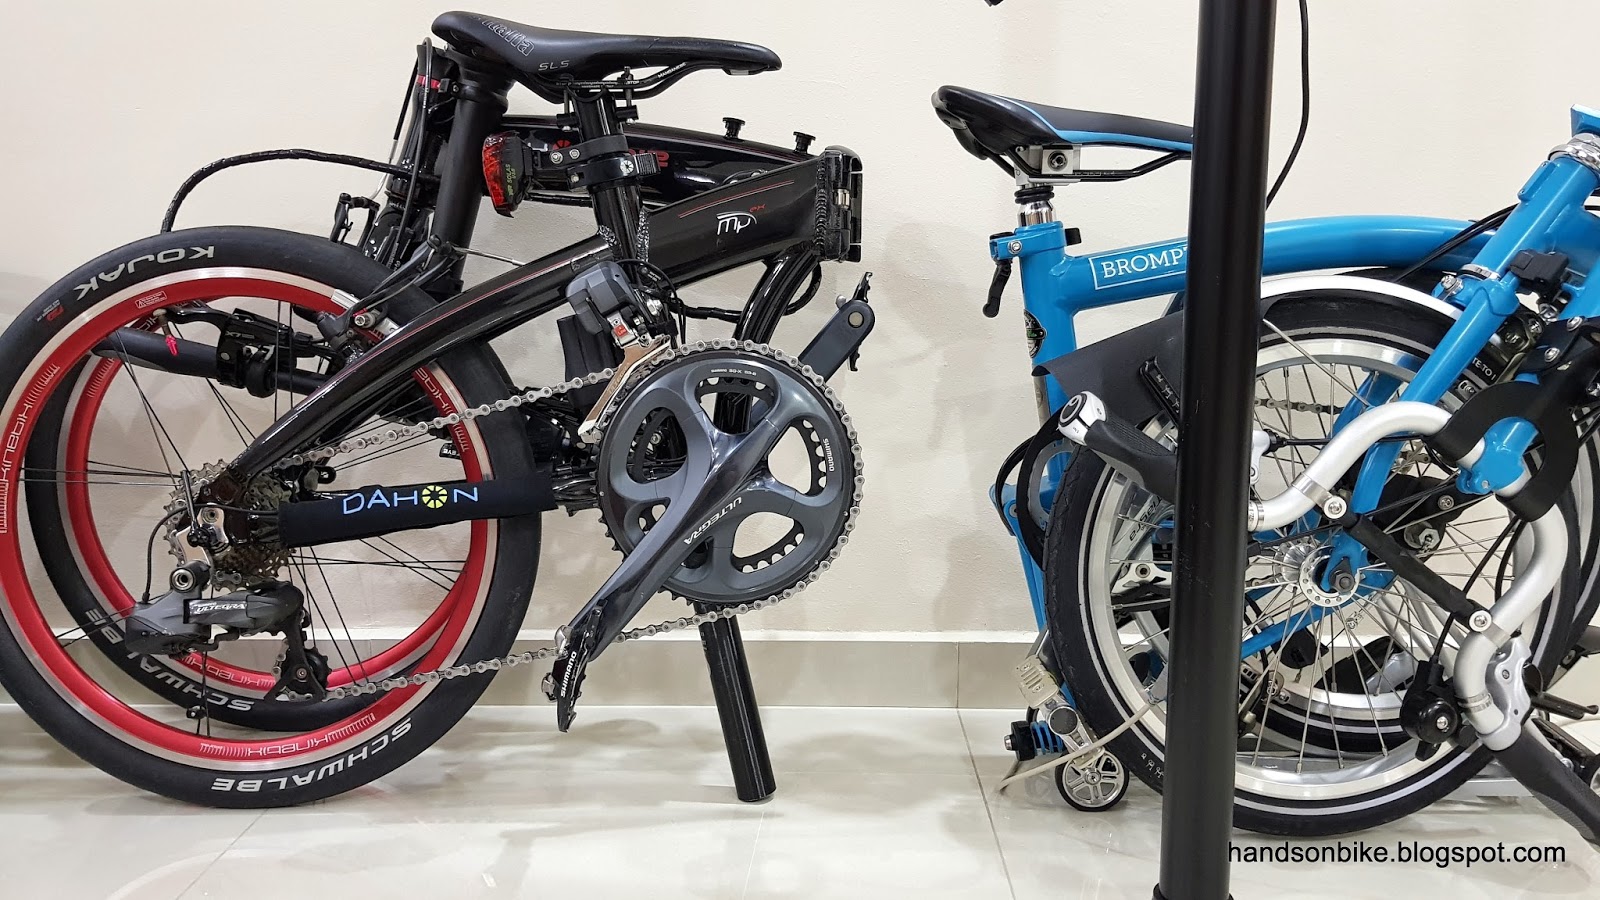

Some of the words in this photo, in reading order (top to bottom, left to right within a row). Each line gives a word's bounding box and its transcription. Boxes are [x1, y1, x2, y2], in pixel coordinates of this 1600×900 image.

[538, 60, 570, 71] SLS
[73, 245, 215, 301] KOJAK
[822, 437, 835, 472] SHIMANO
[342, 484, 480, 515] DAHON
[683, 496, 743, 545] ULTEGRA
[560, 650, 578, 698] SHIMANO
[211, 717, 413, 793] SCHWALBE
